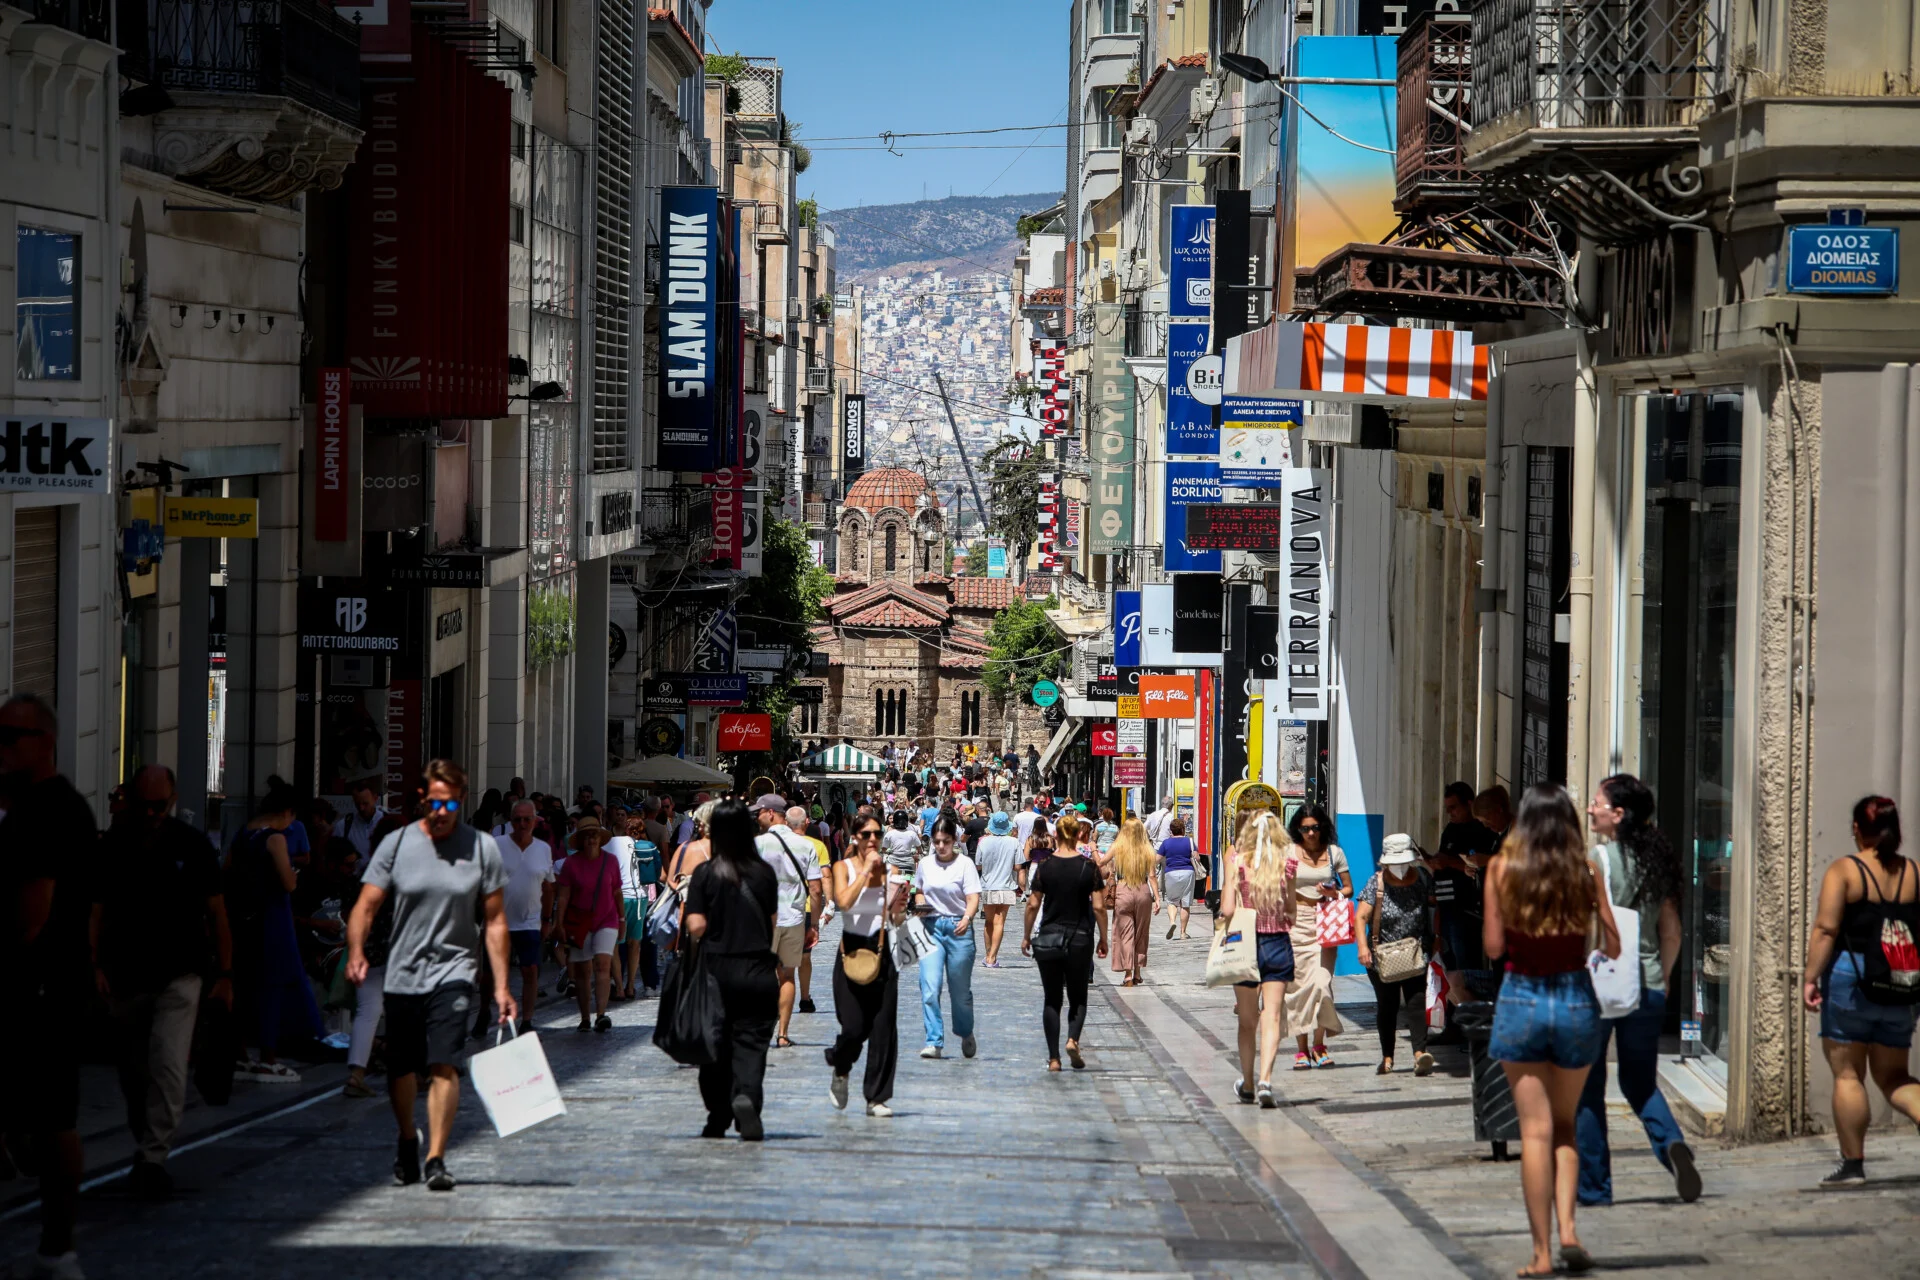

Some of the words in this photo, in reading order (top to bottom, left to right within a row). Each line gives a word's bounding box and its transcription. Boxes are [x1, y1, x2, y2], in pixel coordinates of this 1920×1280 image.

[373, 91, 398, 338] FUNKYBUDDHA
[1841, 211, 1850, 224] 1
[1817, 235, 1870, 249] ΟΔΟΣ
[1174, 247, 1190, 255] LUX
[670, 212, 708, 306] DUNK
[1806, 252, 1880, 265] ΔΙΟΜΕΙΑΣ
[1811, 270, 1876, 284] DIOMIAS
[667, 312, 706, 399] SLAM
[1173, 350, 1207, 358] nordg
[1043, 345, 1066, 435] POP-AIR
[324, 372, 341, 433] HOUSE
[847, 400, 858, 458] COSMOS
[323, 437, 340, 490] LAPIN
[11, 477, 31, 486] FOR
[38, 478, 94, 488] PLEASURE
[1172, 477, 1220, 486] ANNEMARIE
[181, 510, 252, 523] MrPhone.gr
[712, 467, 733, 559] Hondo
[1042, 481, 1060, 567] POP-AIR
[391, 568, 481, 581] FUNKYBUDDHA
[1287, 486, 1321, 702] TERRANOVA
[302, 634, 399, 651] ANTETOKOUNBROS
[707, 679, 741, 689] LUCCI
[327, 694, 356, 703] ecco
[646, 696, 683, 704] MATSOUKA
[1145, 690, 1164, 704] Folli
[1166, 689, 1189, 703] Follie
